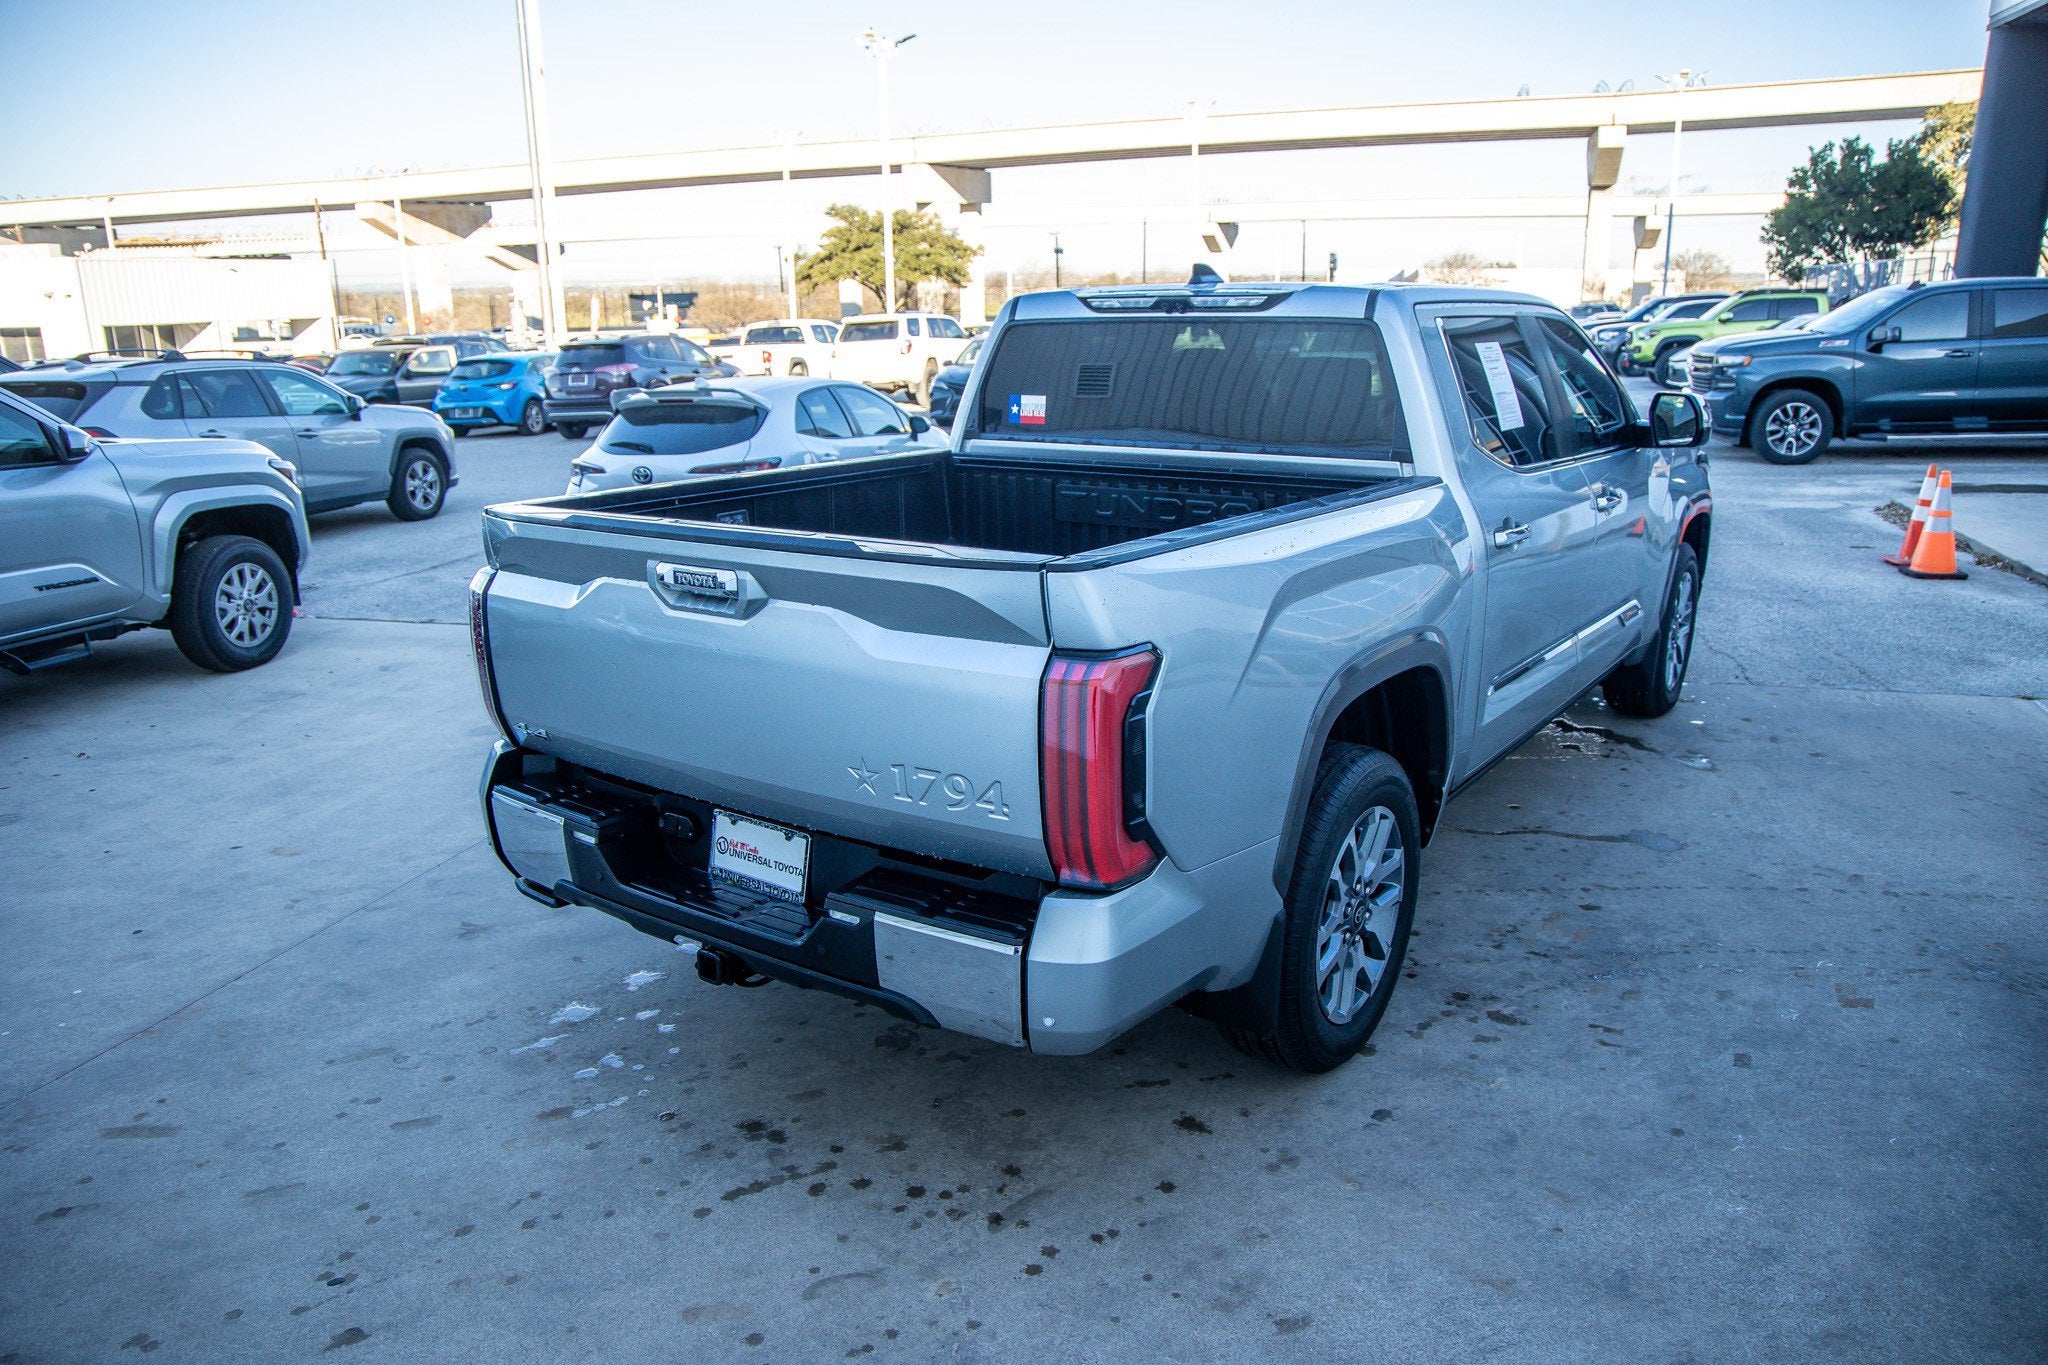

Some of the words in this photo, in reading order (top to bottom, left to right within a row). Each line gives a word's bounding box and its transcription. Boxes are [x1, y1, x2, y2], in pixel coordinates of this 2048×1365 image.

[34, 577, 99, 592] TACOMA
[676, 572, 716, 589] TOYOTA
[890, 763, 1010, 821] 1794
[729, 848, 772, 869] UNIVERSAL
[773, 860, 804, 877] TOYOTA
[721, 869, 767, 892] UNIVERSAL
[768, 884, 802, 903] TOYOTA
